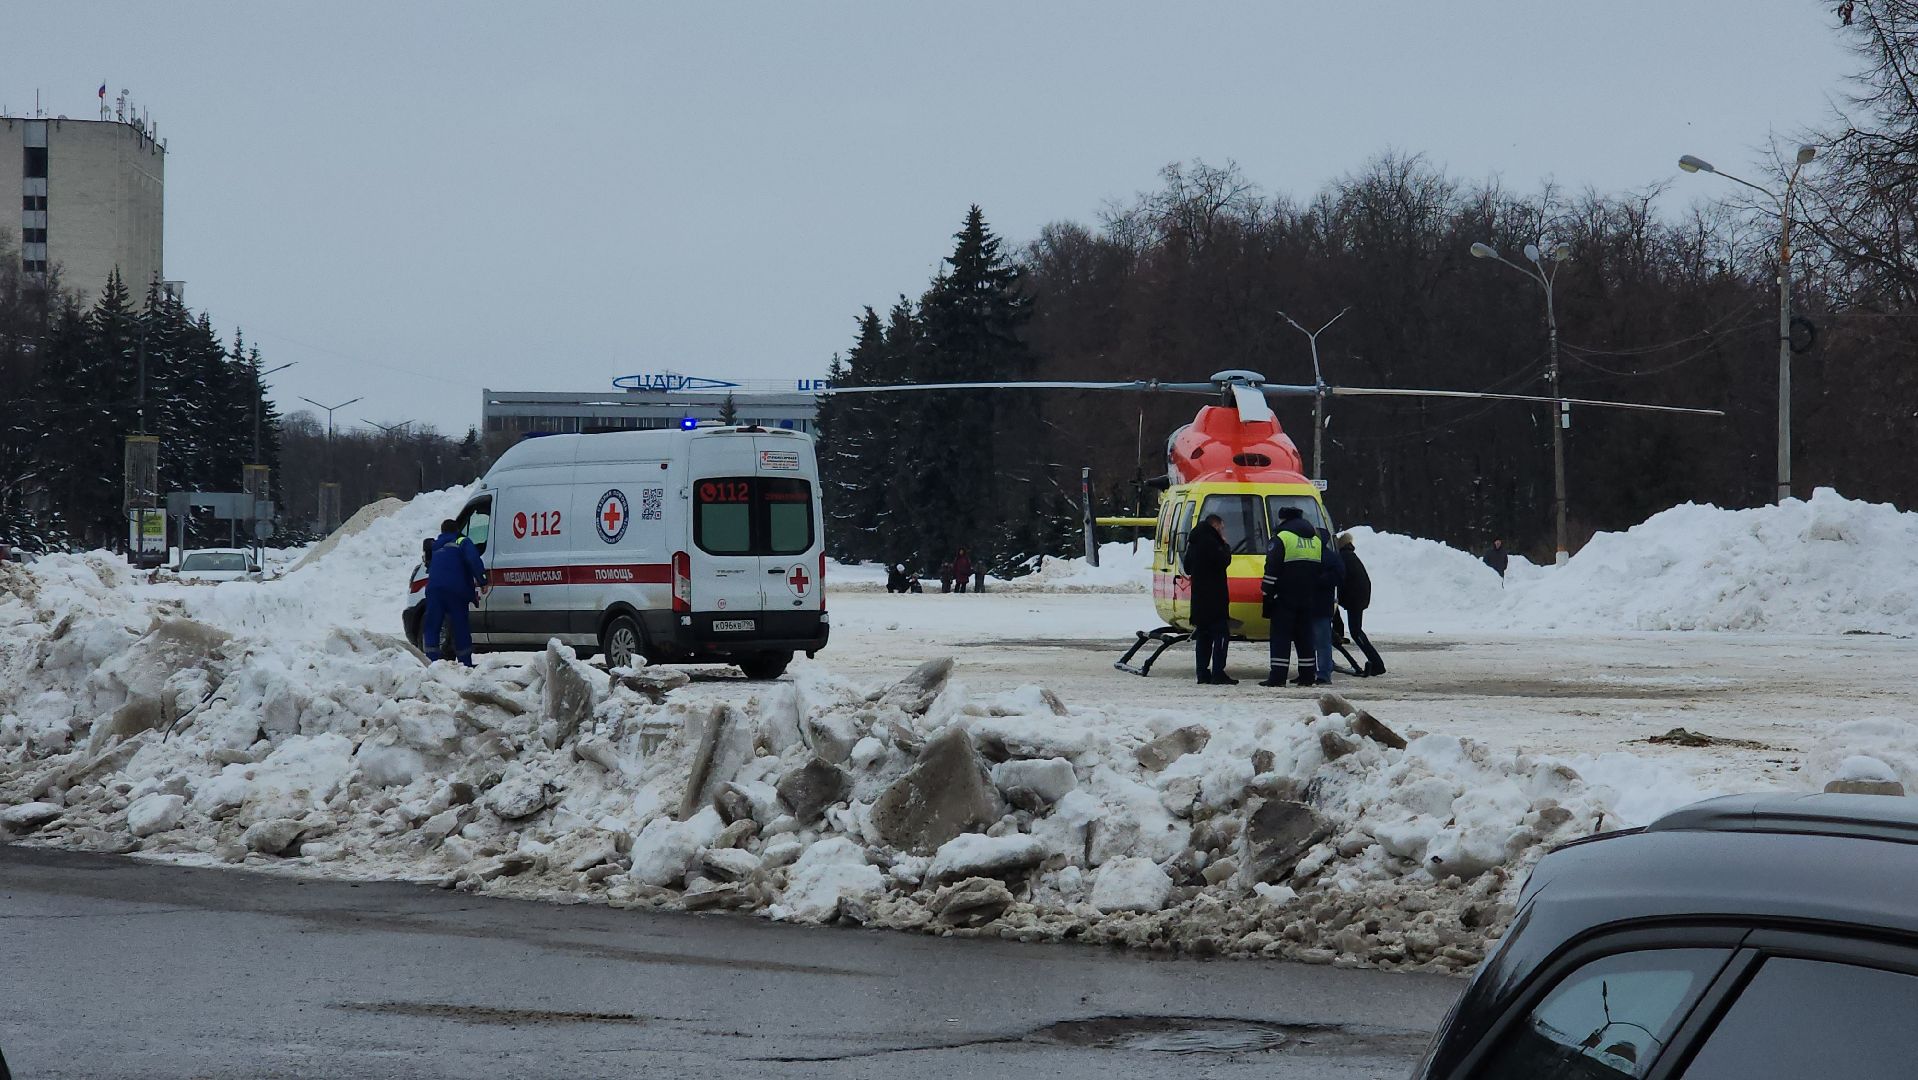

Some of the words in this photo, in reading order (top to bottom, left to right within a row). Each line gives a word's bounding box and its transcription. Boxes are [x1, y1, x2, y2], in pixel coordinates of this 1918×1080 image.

[637, 374, 692, 391] ЦАГИ
[716, 482, 749, 502] 112
[531, 511, 561, 536] 112
[503, 570, 563, 584] МЕДИЦИНСКАЯ
[594, 568, 634, 582] ПОМОЩЬ
